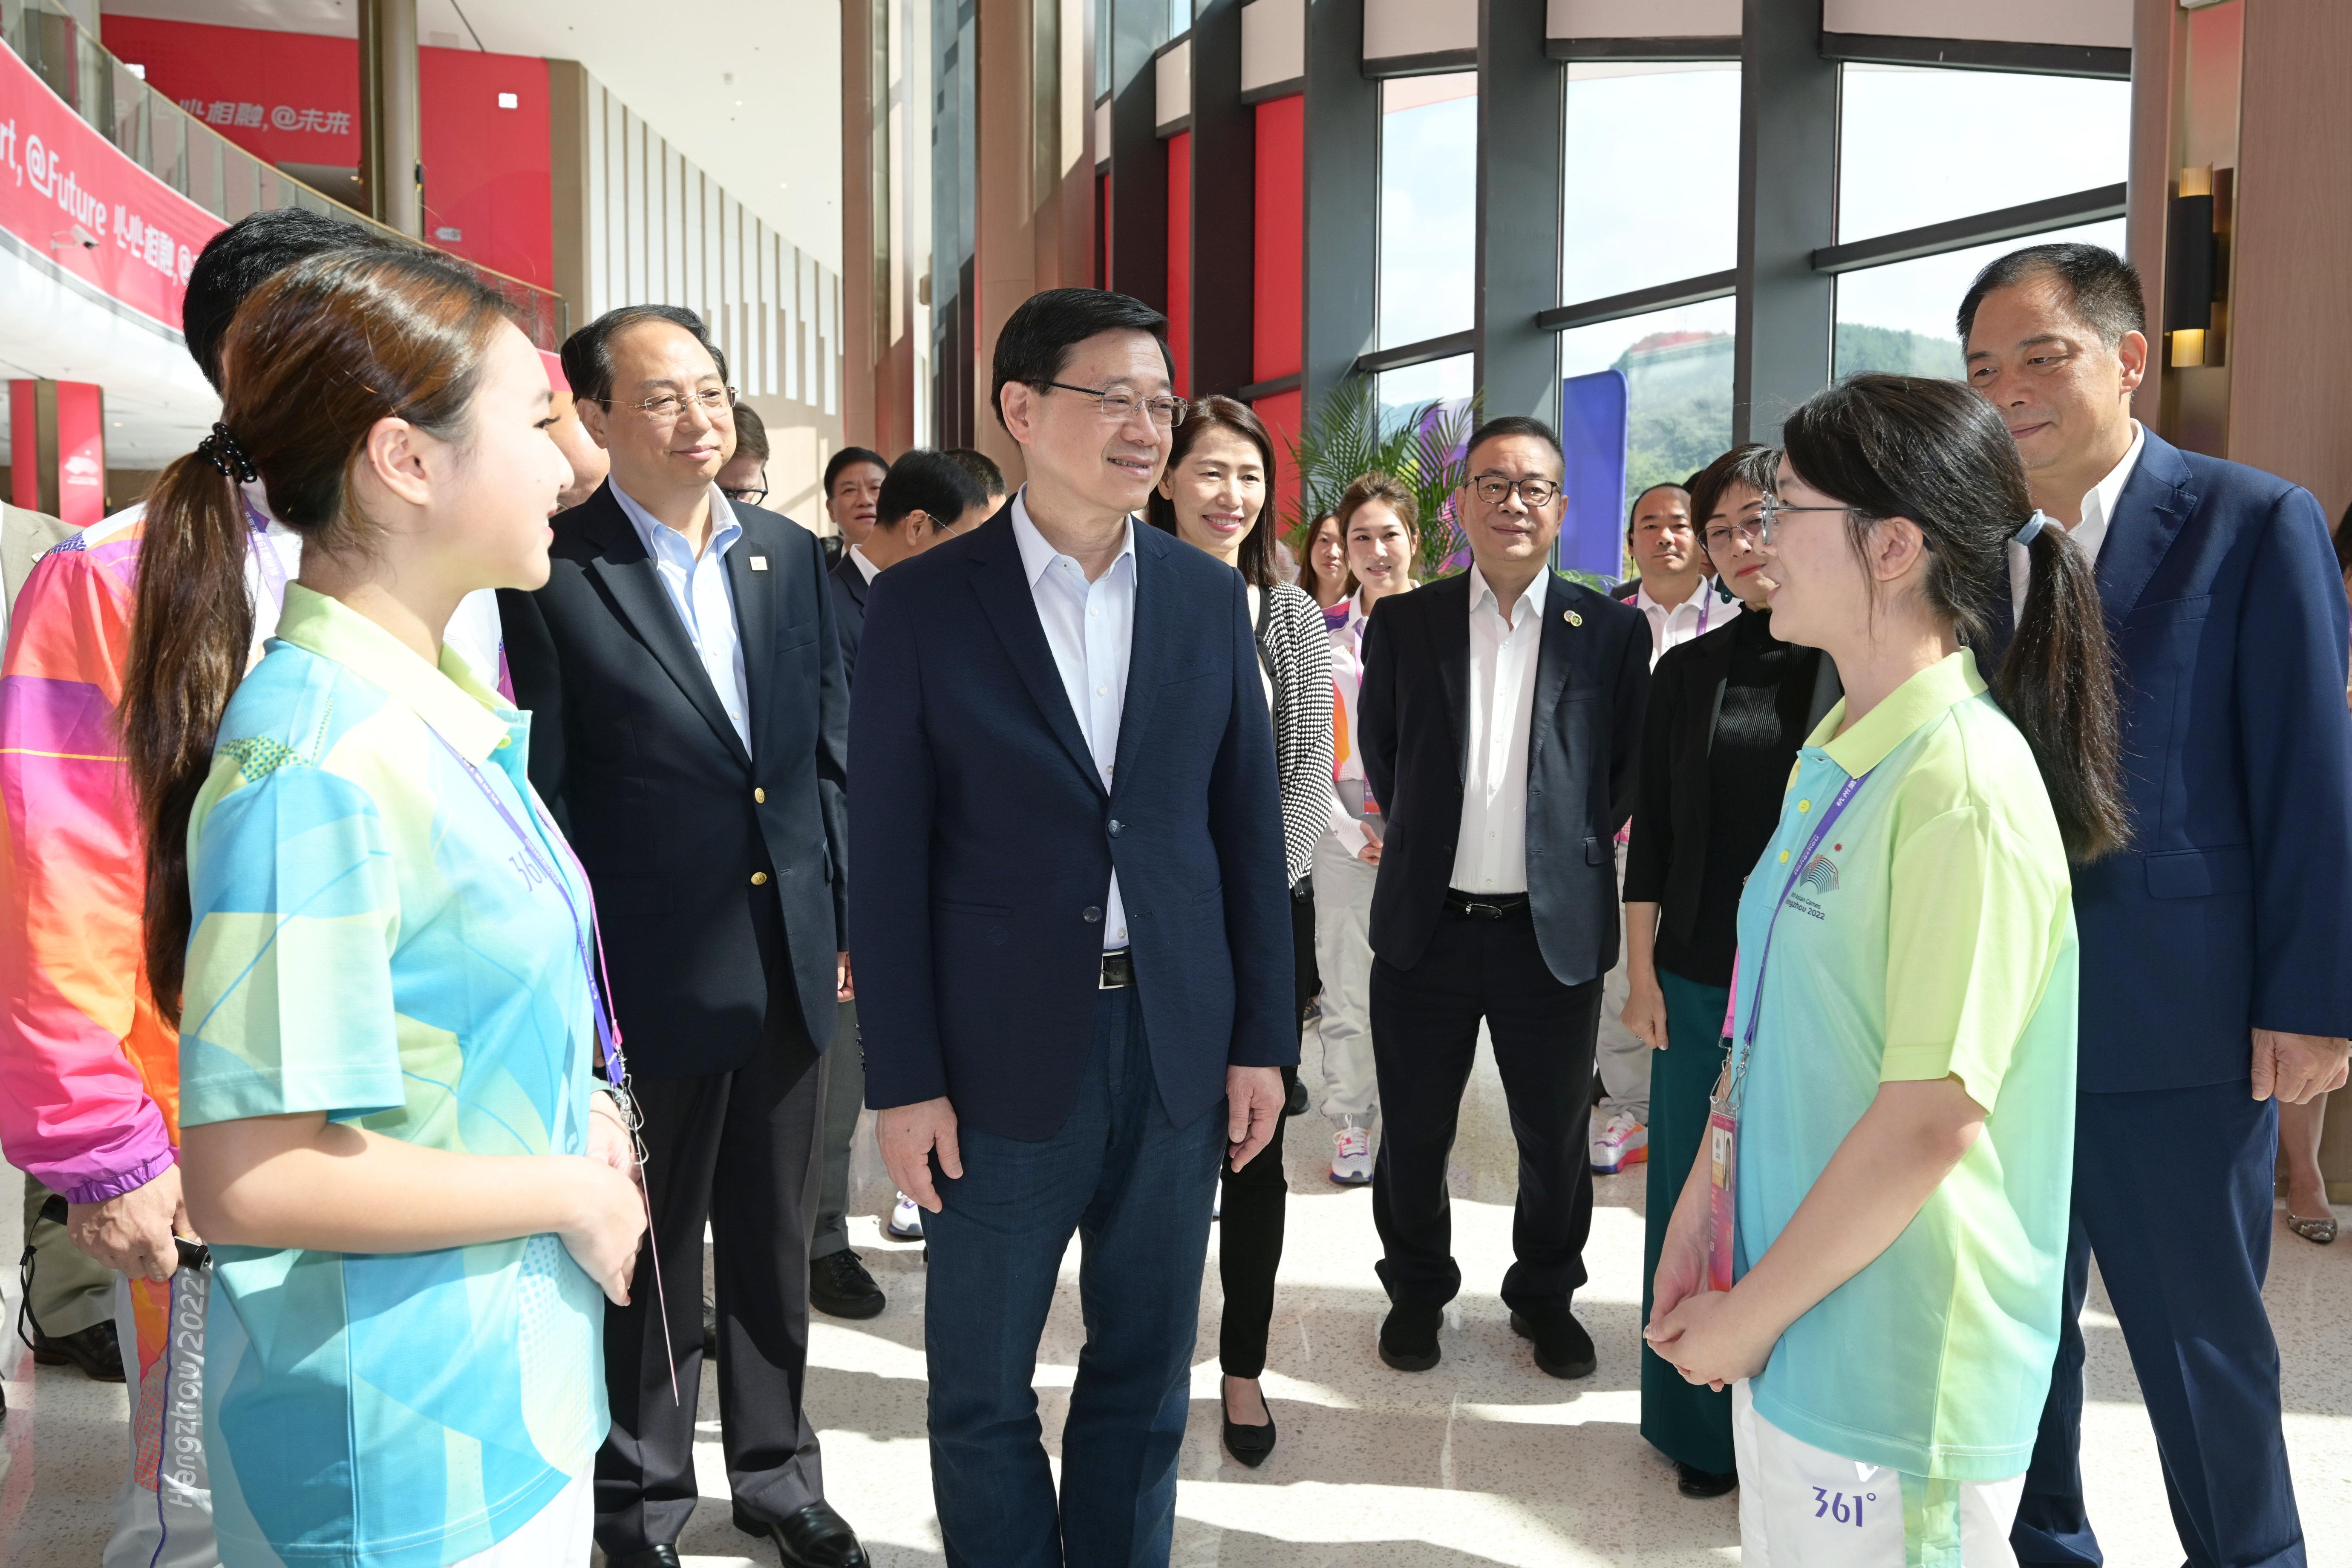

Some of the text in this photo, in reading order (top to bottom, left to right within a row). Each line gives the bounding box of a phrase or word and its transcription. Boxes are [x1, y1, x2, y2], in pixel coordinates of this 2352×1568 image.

[26, 134, 107, 236] @Future
[1795, 894, 1806, 903] Asian
[1805, 899, 1821, 910] Games
[1807, 908, 1825, 920] 2022
[168, 1276, 205, 1507] Hangzhou 2022
